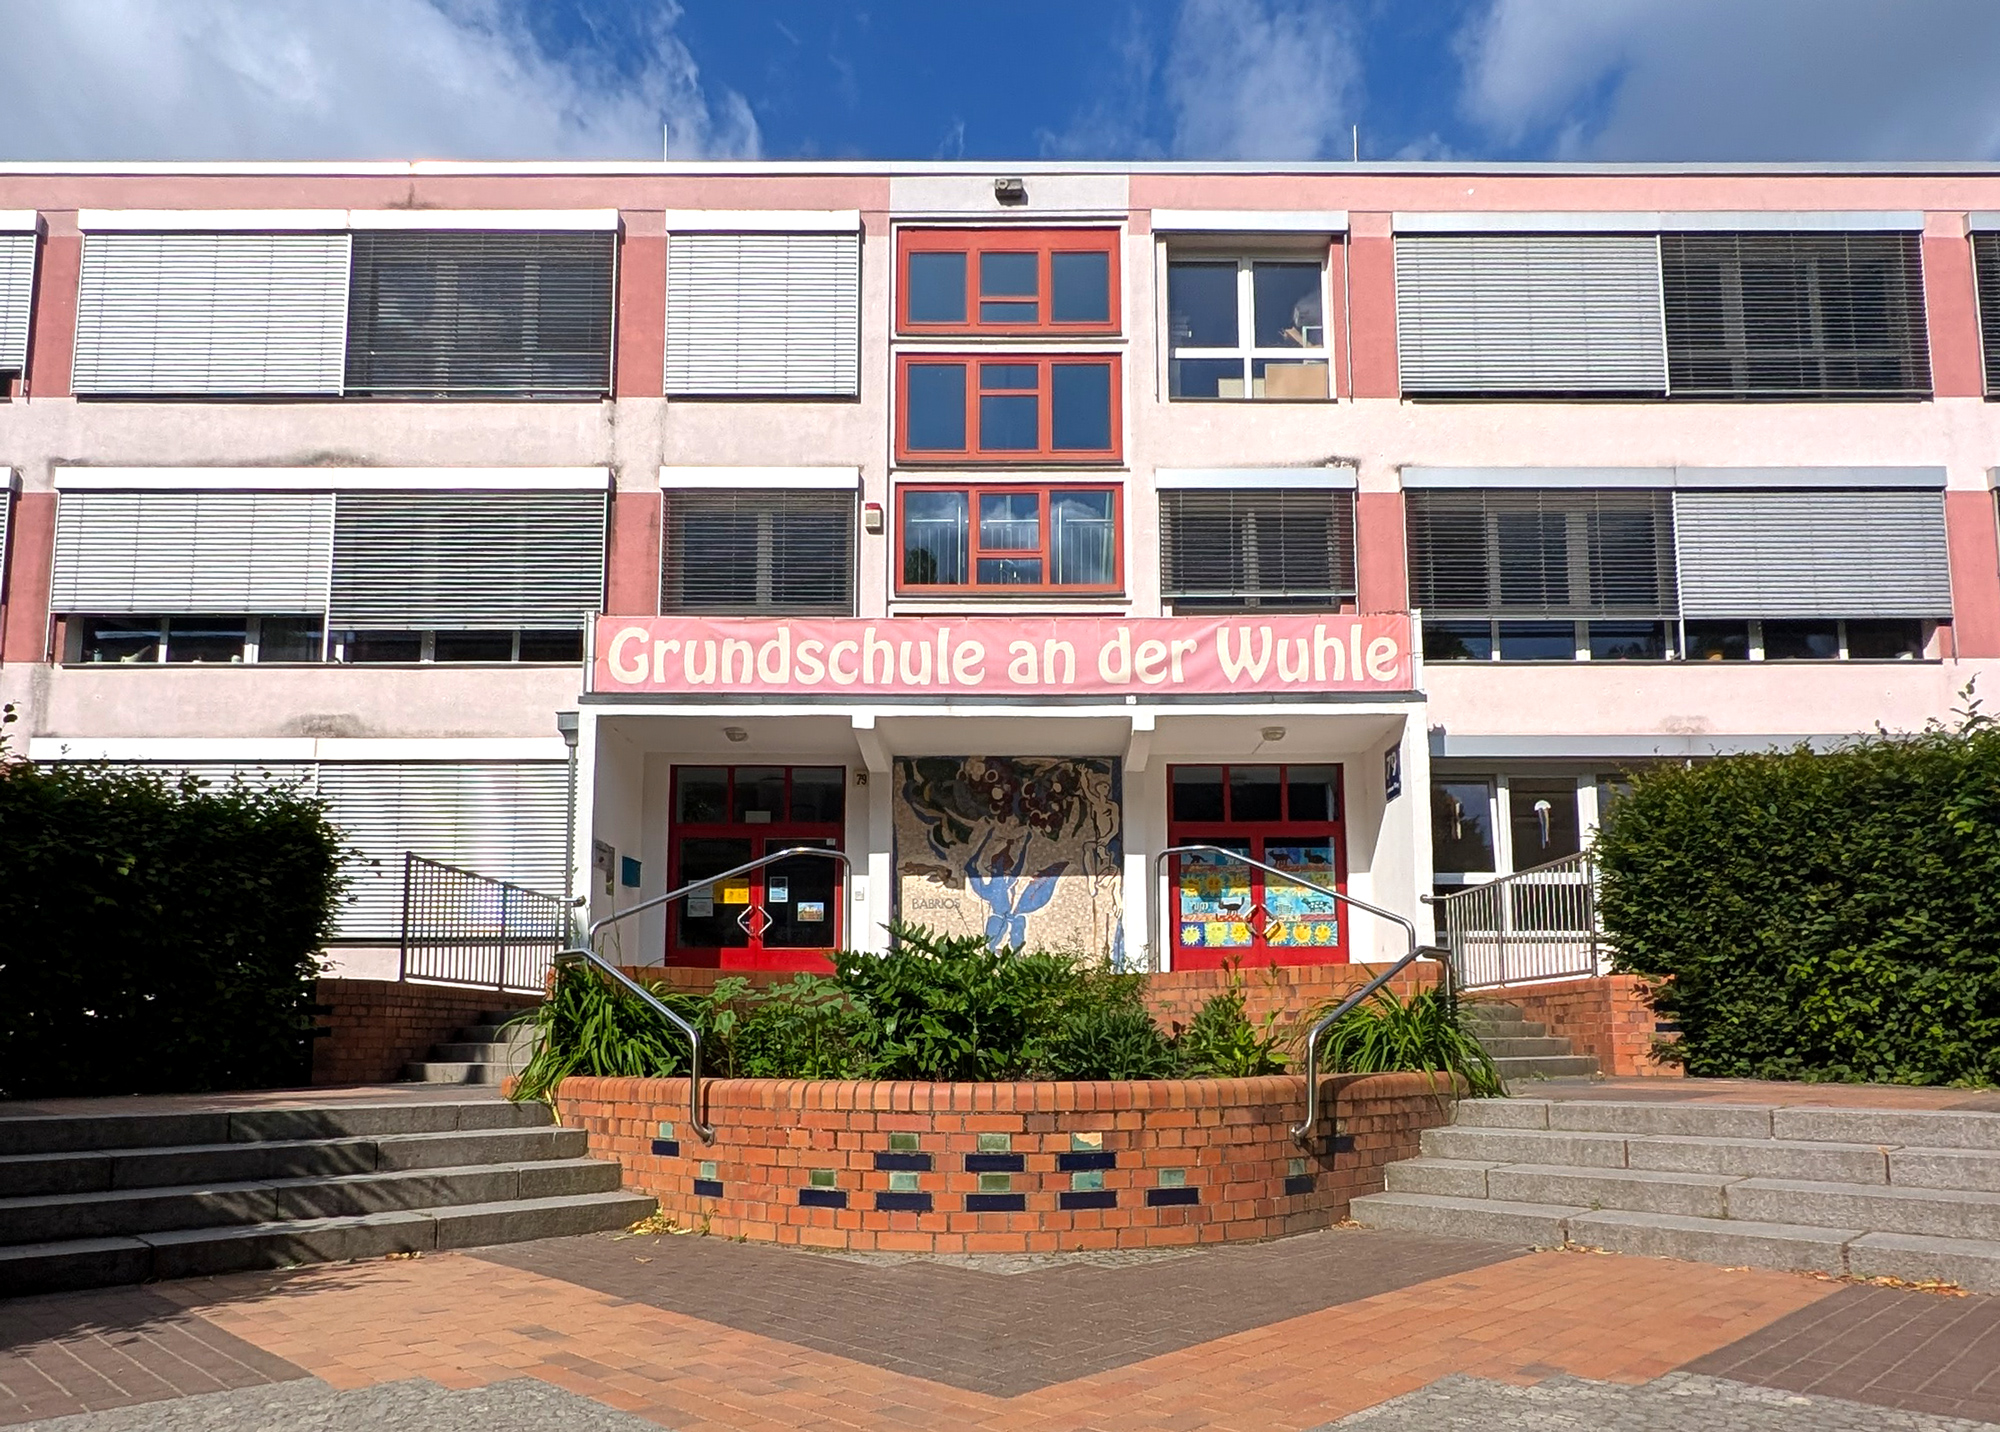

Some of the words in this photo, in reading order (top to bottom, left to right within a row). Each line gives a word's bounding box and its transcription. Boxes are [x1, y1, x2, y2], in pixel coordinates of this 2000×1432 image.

[607, 626, 986, 686] Grundschule
[1007, 638, 1076, 685] an
[1098, 626, 1198, 685] der
[1216, 624, 1399, 684] Wuhle
[1386, 751, 1397, 780] 79
[856, 773, 867, 786] 79
[911, 897, 961, 910] BABRIOS
